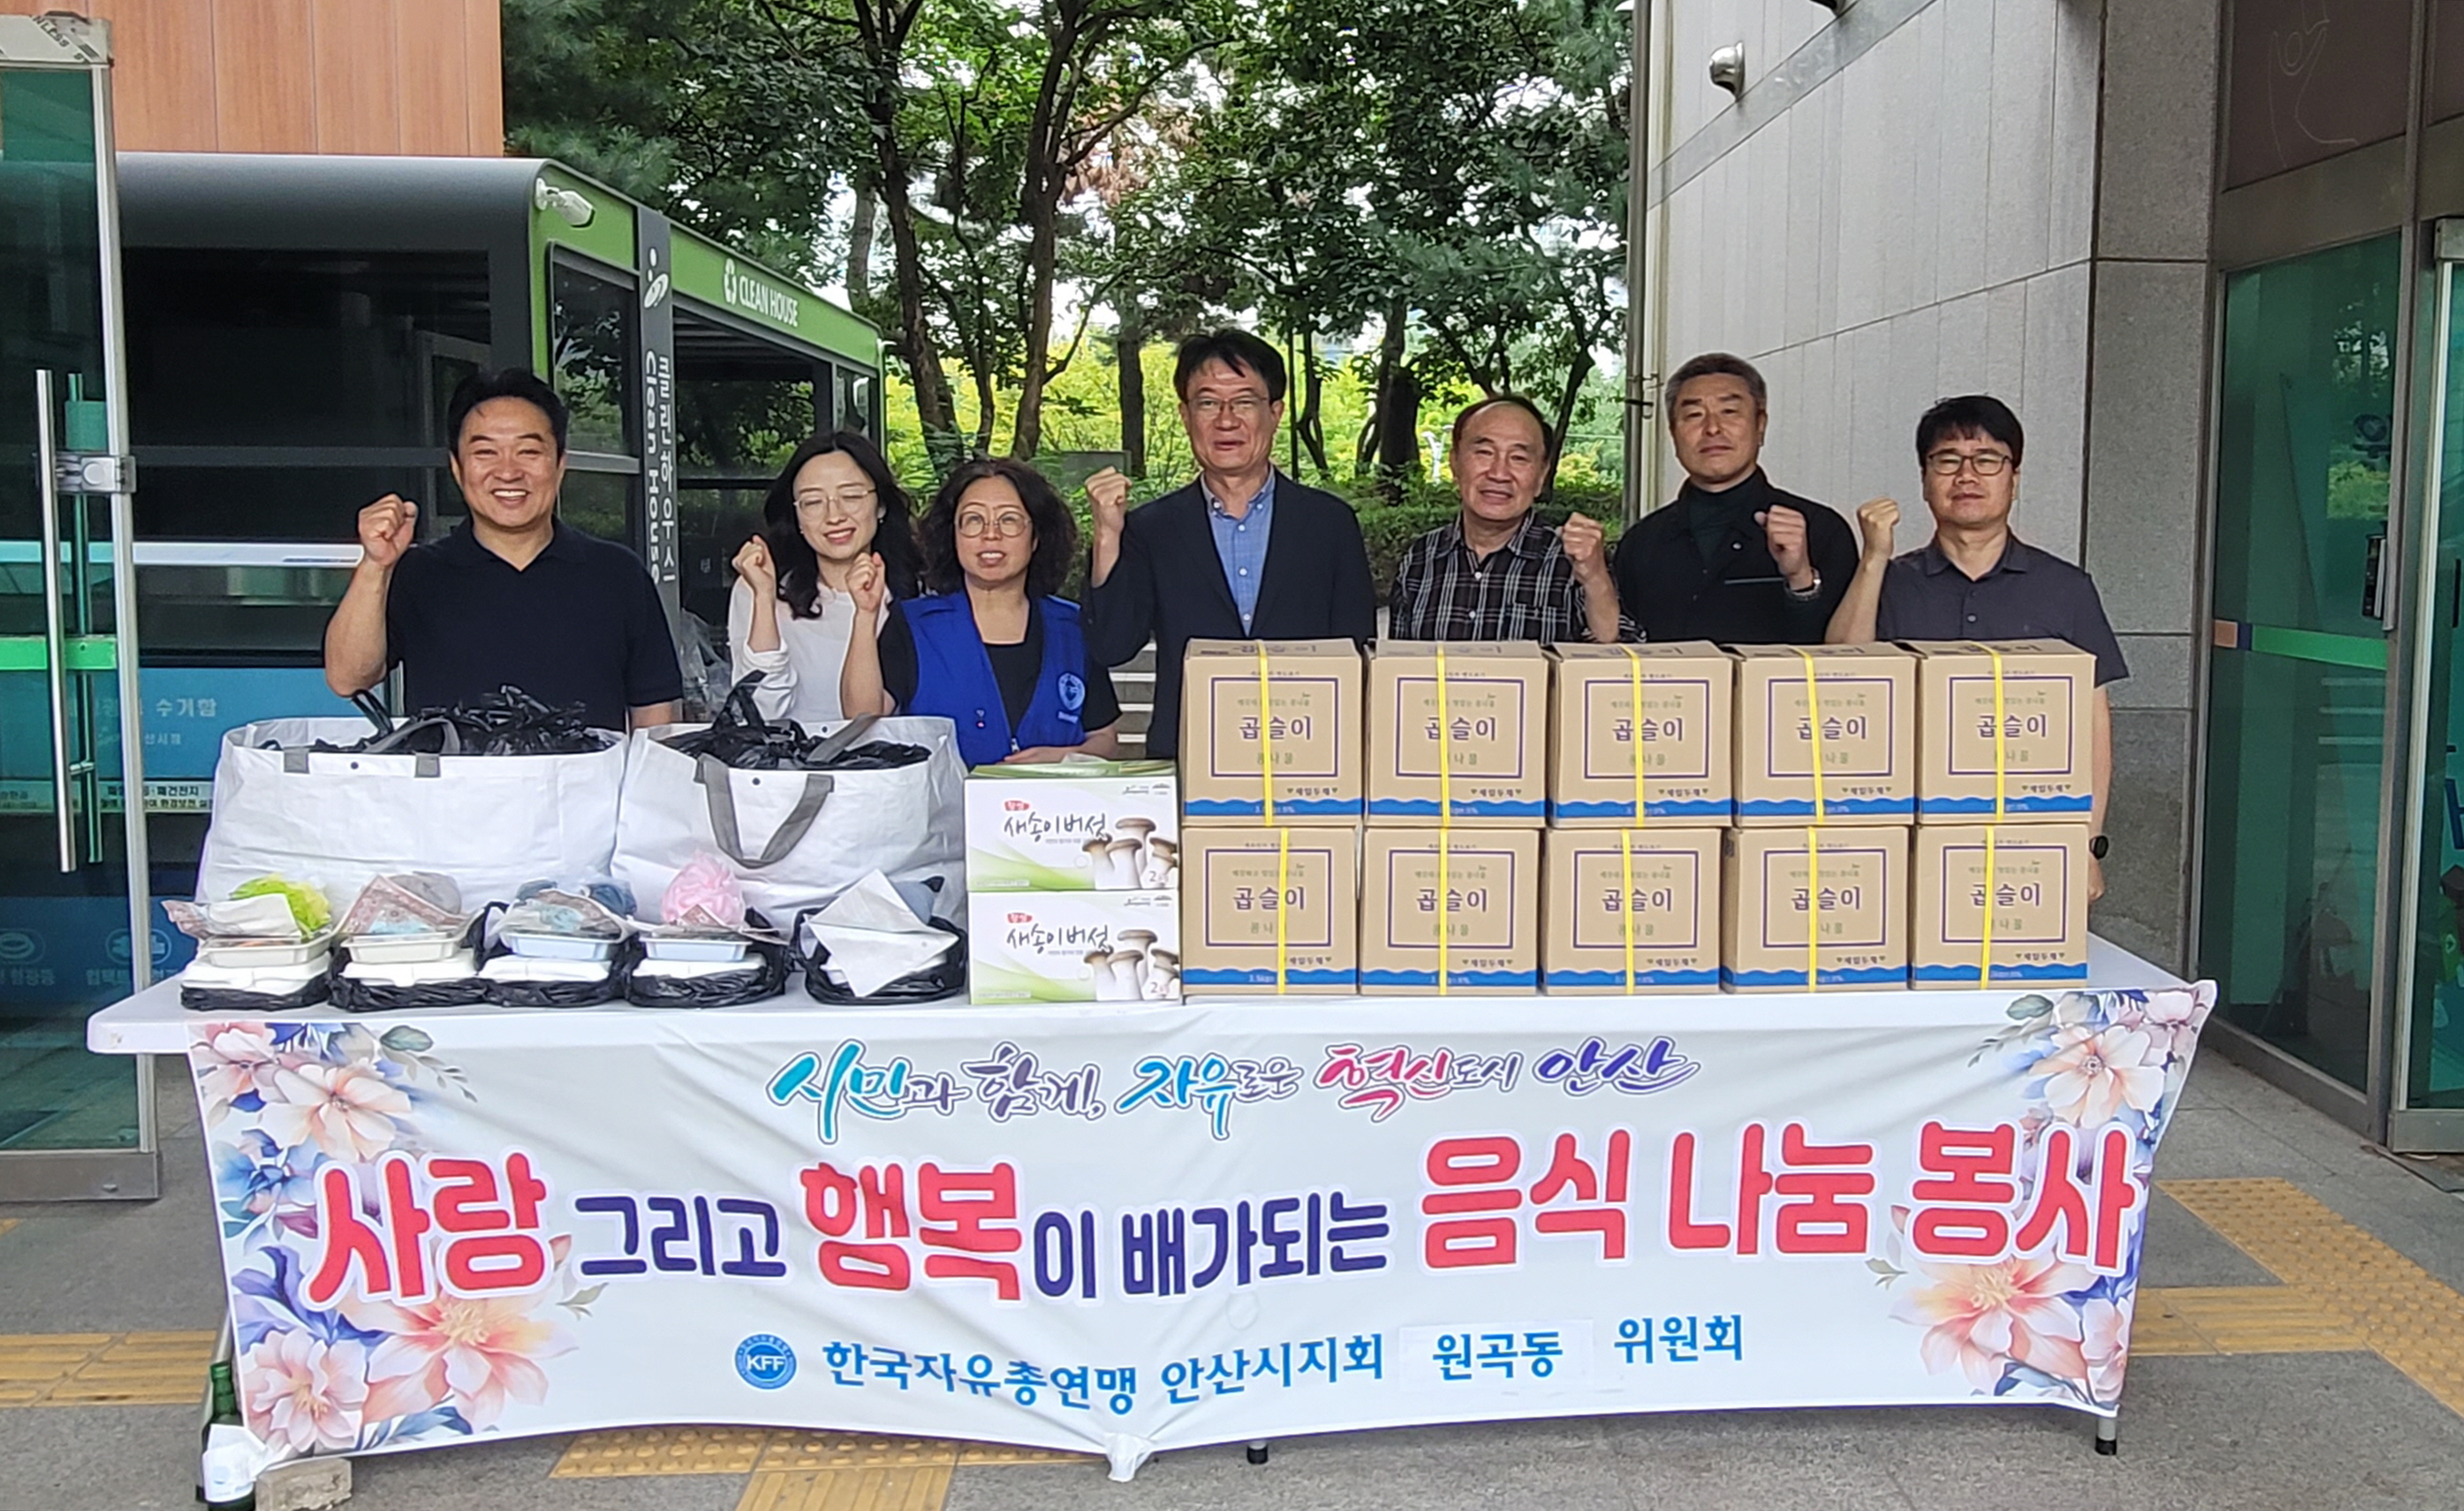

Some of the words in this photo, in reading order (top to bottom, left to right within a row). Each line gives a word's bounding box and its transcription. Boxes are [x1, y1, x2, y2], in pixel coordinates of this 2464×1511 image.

[739, 274, 768, 315] CLEAN
[769, 288, 798, 328] HOUSE
[645, 351, 658, 454] Clean
[658, 355, 677, 583] 클린하우스
[648, 469, 661, 585] House
[156, 698, 218, 718] 수거함
[1239, 715, 1311, 741] 곱슬이
[1424, 717, 1496, 742] 곱슬이
[1612, 717, 1684, 742] 곱슬이
[1796, 716, 1867, 740] 곱슬이
[1977, 713, 2046, 738] 곱슬이
[1233, 886, 1305, 911] 곱슬이
[1417, 888, 1487, 912] 곱슬이
[1602, 888, 1673, 912] 곱슬이
[1790, 886, 1861, 911] 곱슬이
[1969, 882, 2041, 907] 곱슬이
[767, 1038, 971, 1144] 시민과
[1115, 1053, 1305, 1140] 자유로운
[1314, 1042, 1525, 1123] 혁신도시
[1532, 1036, 1701, 1097] 안산
[307, 1153, 547, 1304] 사랑
[575, 1194, 787, 1277] 그리고
[800, 1161, 1097, 1301] 행복이
[1122, 1191, 1388, 1297] 배가되는
[1421, 1128, 1631, 1270] 음식
[1668, 1122, 1876, 1256] 나눔
[1911, 1120, 2137, 1270] 봉사
[746, 1353, 787, 1371] KFF
[823, 1340, 1137, 1416] 한국자유총연맹
[1160, 1333, 1383, 1404] 안산시지회
[1431, 1330, 1564, 1382] 원곡동
[1613, 1314, 1744, 1364] 위원회
